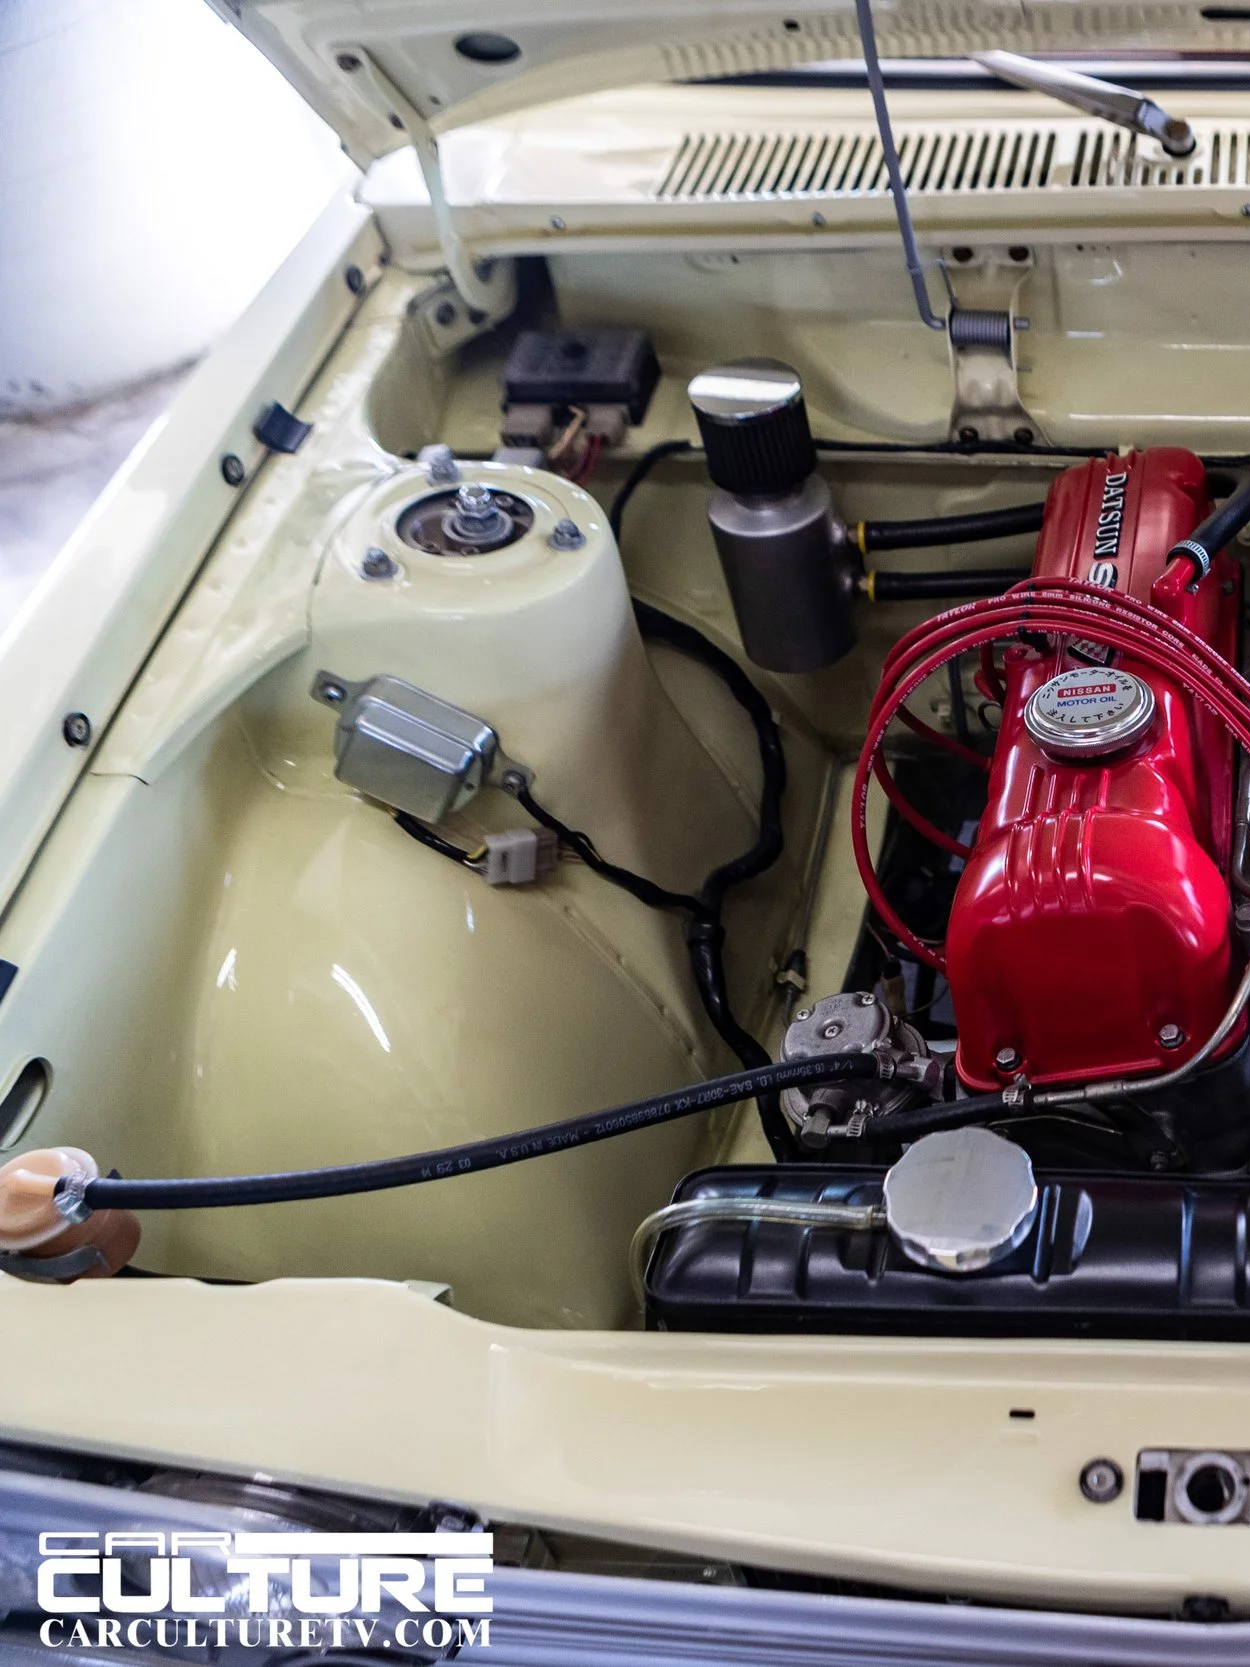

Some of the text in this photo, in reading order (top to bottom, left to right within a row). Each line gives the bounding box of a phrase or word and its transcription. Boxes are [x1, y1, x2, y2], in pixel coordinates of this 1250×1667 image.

[1094, 471, 1128, 556] DATSUN
[1124, 594, 1143, 605] PRO
[1147, 605, 1169, 619] WIRE
[936, 602, 977, 622] TAYLOR
[987, 595, 1007, 605] PRO
[1011, 591, 1036, 600] WIRE
[1041, 591, 1064, 599] 8mm
[1069, 594, 1111, 609] SILICONE
[1115, 607, 1159, 632] RESISTOR
[1162, 630, 1186, 649] CORE
[1191, 653, 1213, 676] MADE
[1063, 685, 1111, 697] NISSAN
[1057, 697, 1097, 708] MOTOR
[532, 1141, 544, 1151] IN
[546, 1129, 581, 1146] MADE
